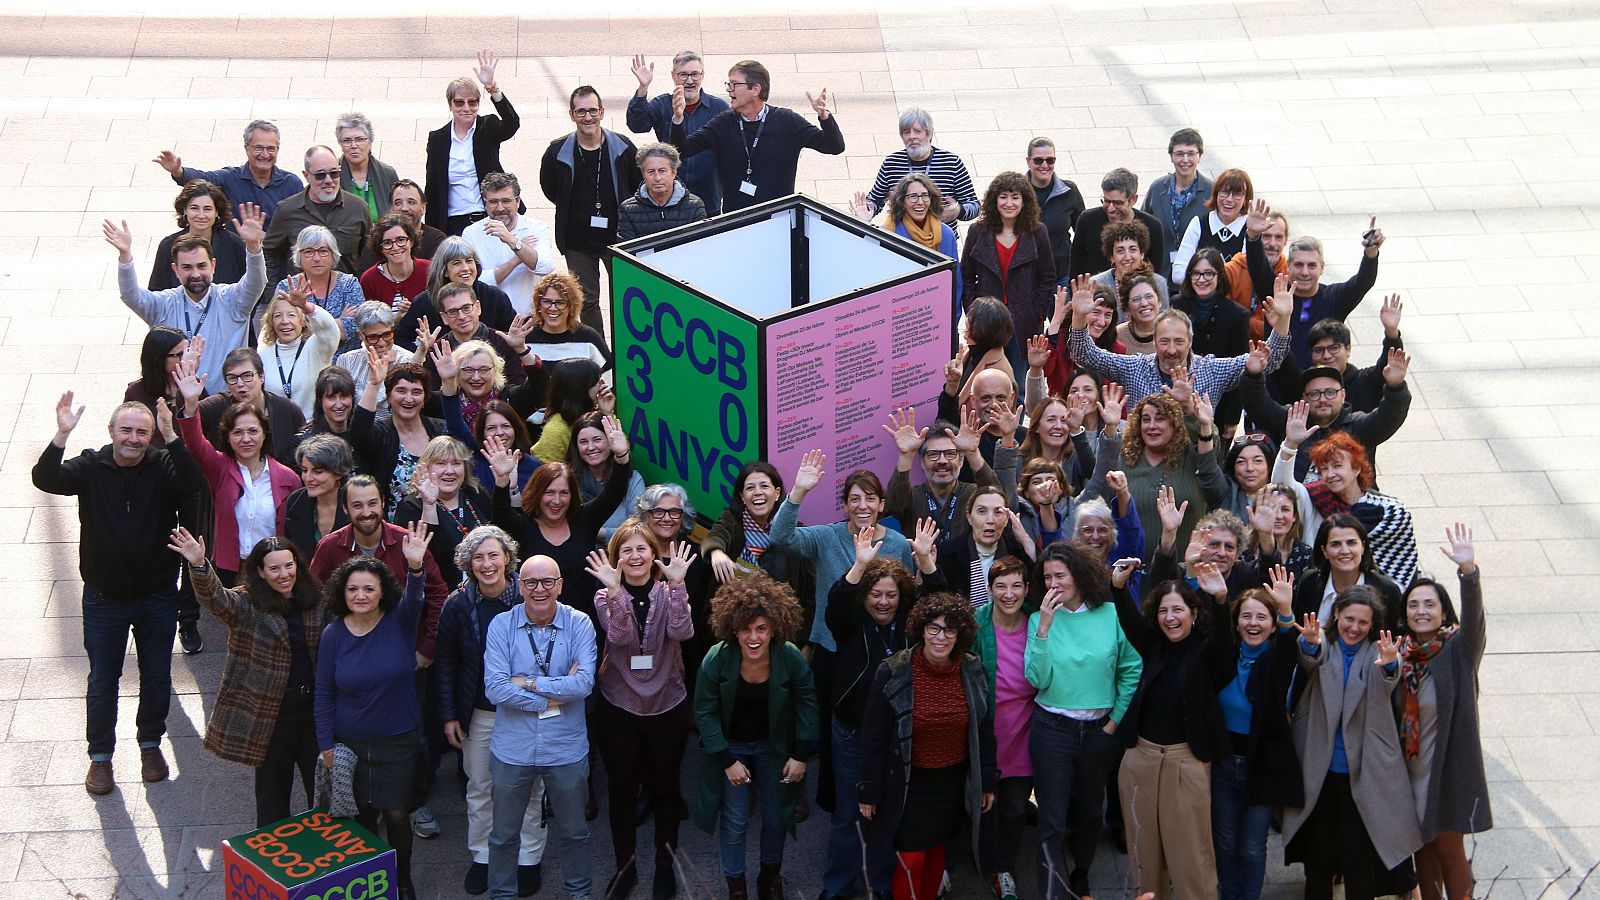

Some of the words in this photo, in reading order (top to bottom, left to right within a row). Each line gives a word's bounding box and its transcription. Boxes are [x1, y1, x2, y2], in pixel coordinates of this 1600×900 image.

[892, 292, 914, 304] Diumenge
[835, 311, 854, 321] Dissabte
[867, 303, 880, 312] febrer
[892, 309, 917, 321] Inauguració
[812, 321, 824, 329] febrer
[854, 323, 871, 332] Mirador
[892, 325, 918, 338] experiments
[905, 330, 918, 339] CCCB
[623, 286, 747, 391] CCCB
[777, 349, 789, 357] Festa
[835, 344, 860, 356] Inauguració
[777, 352, 798, 363] Programa
[835, 360, 862, 373] experiments
[849, 365, 862, 374] CCCB
[892, 368, 905, 377] Portes
[863, 372, 876, 380] Dones
[892, 384, 908, 393] Entrada
[836, 403, 849, 412] Portes
[850, 397, 866, 407] obertes
[777, 422, 792, 431] Portes
[793, 417, 809, 426] obertes
[836, 419, 852, 429] Entrada
[853, 415, 863, 423] lliure
[836, 426, 851, 435] reserva
[778, 438, 794, 448] Entrada
[796, 434, 806, 442] lliure
[778, 445, 794, 454] reserva
[857, 447, 866, 455] amb
[629, 406, 746, 506] ANYS
[302, 812, 377, 855] ANYS
[245, 832, 316, 878] CCCB
